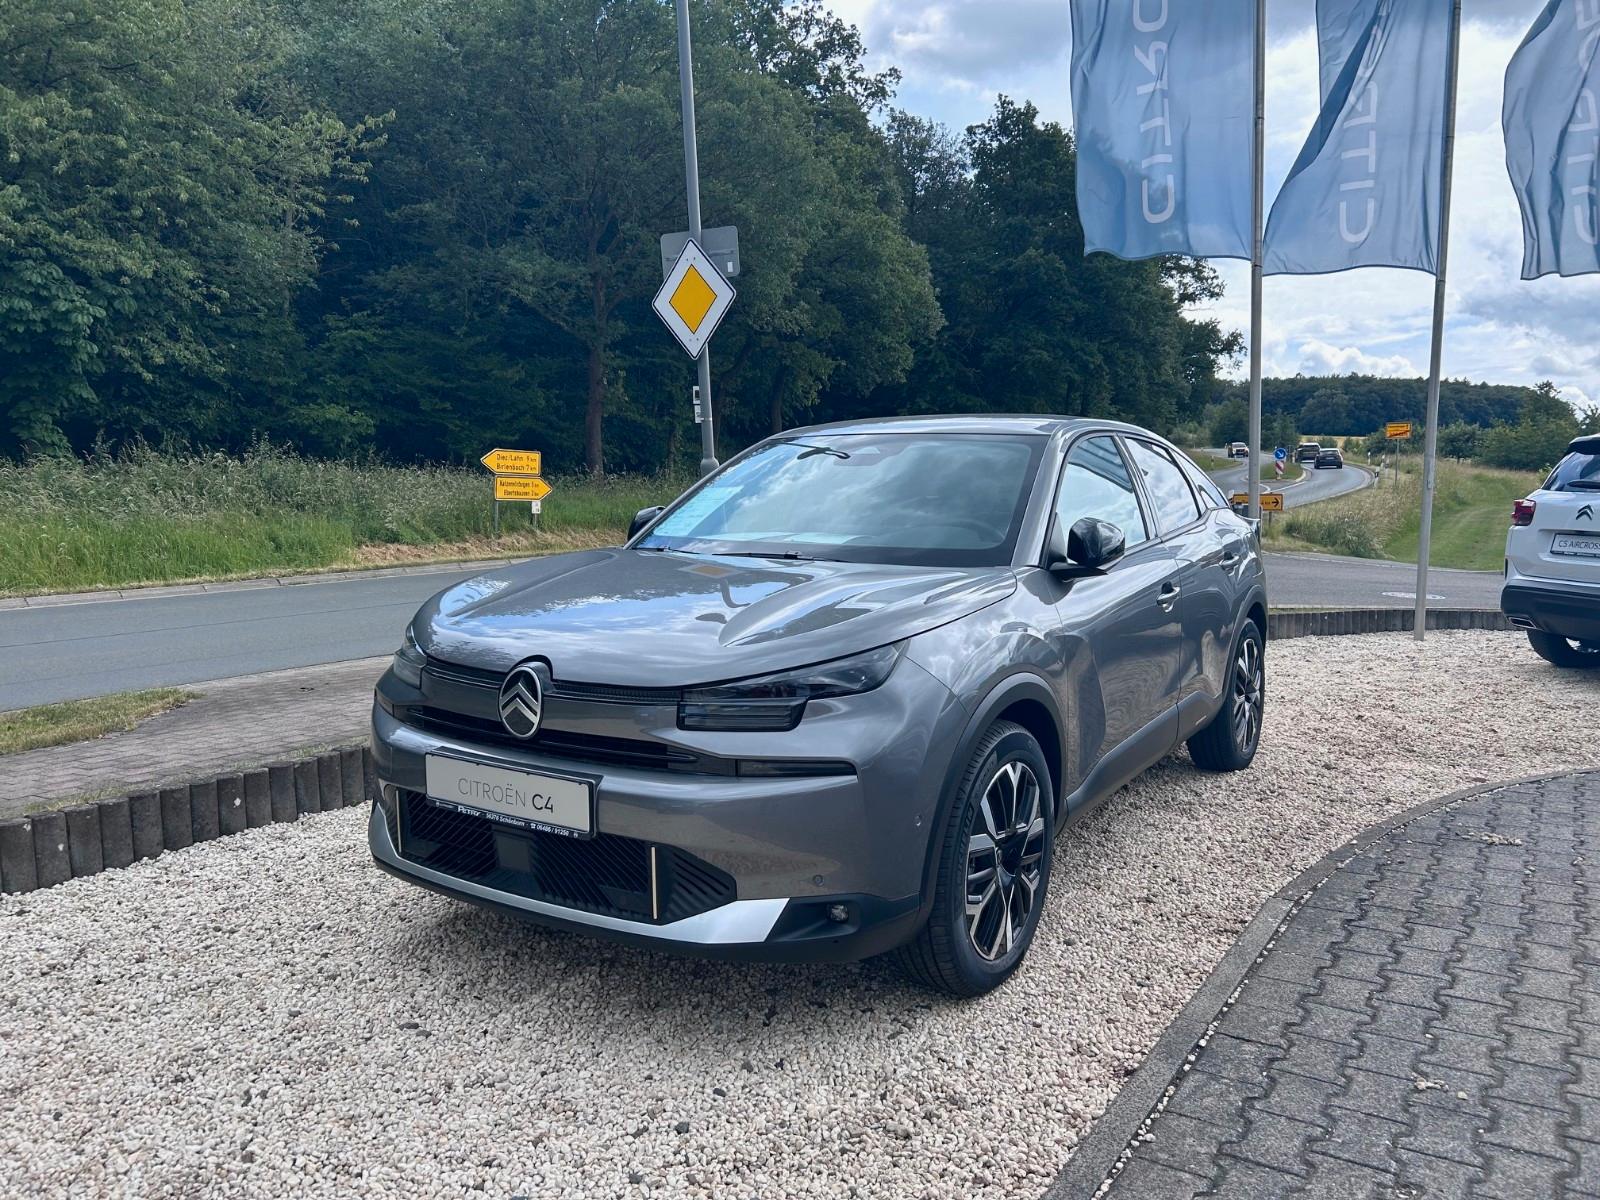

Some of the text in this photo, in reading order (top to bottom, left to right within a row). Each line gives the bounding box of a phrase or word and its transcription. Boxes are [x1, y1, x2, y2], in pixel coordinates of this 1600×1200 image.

[1568, 540, 1600, 550] AIRCROS
[457, 778, 554, 813] CITROËN C4
